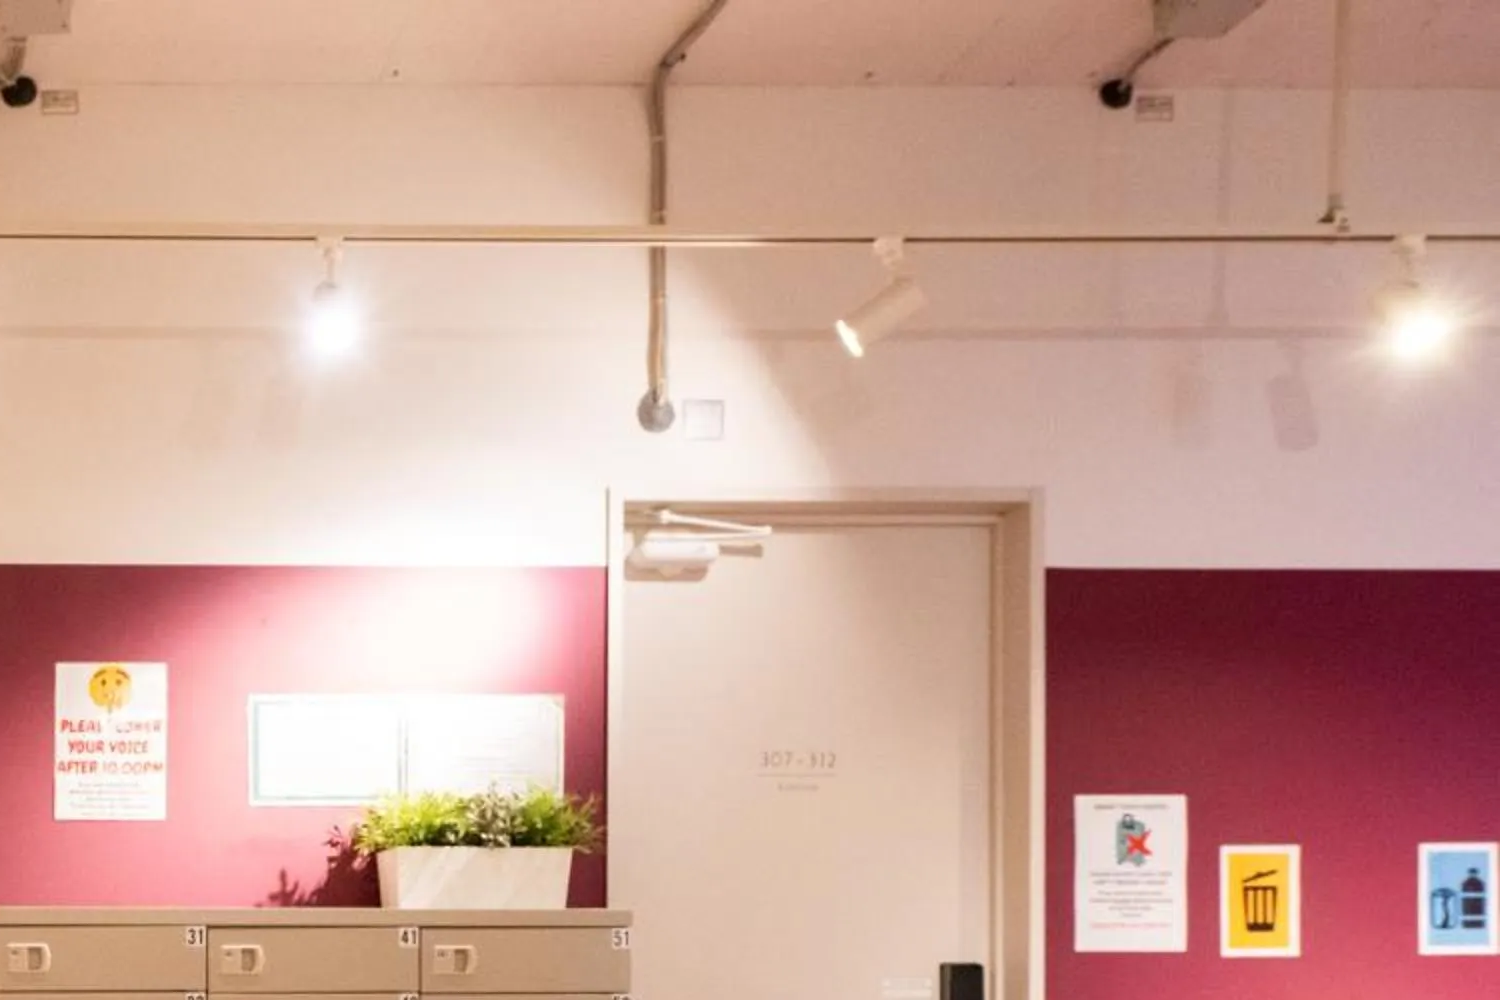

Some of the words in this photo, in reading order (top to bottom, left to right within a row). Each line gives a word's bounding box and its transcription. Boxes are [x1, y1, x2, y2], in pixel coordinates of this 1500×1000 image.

[60, 719, 103, 733] PLEA
[68, 739, 105, 754] YOUR
[109, 739, 149, 754] VOICE
[57, 760, 98, 775] AFTER
[102, 760, 164, 775] 1000PM
[187, 928, 203, 945] 31
[401, 929, 417, 945] 41
[613, 930, 629, 946] 51
